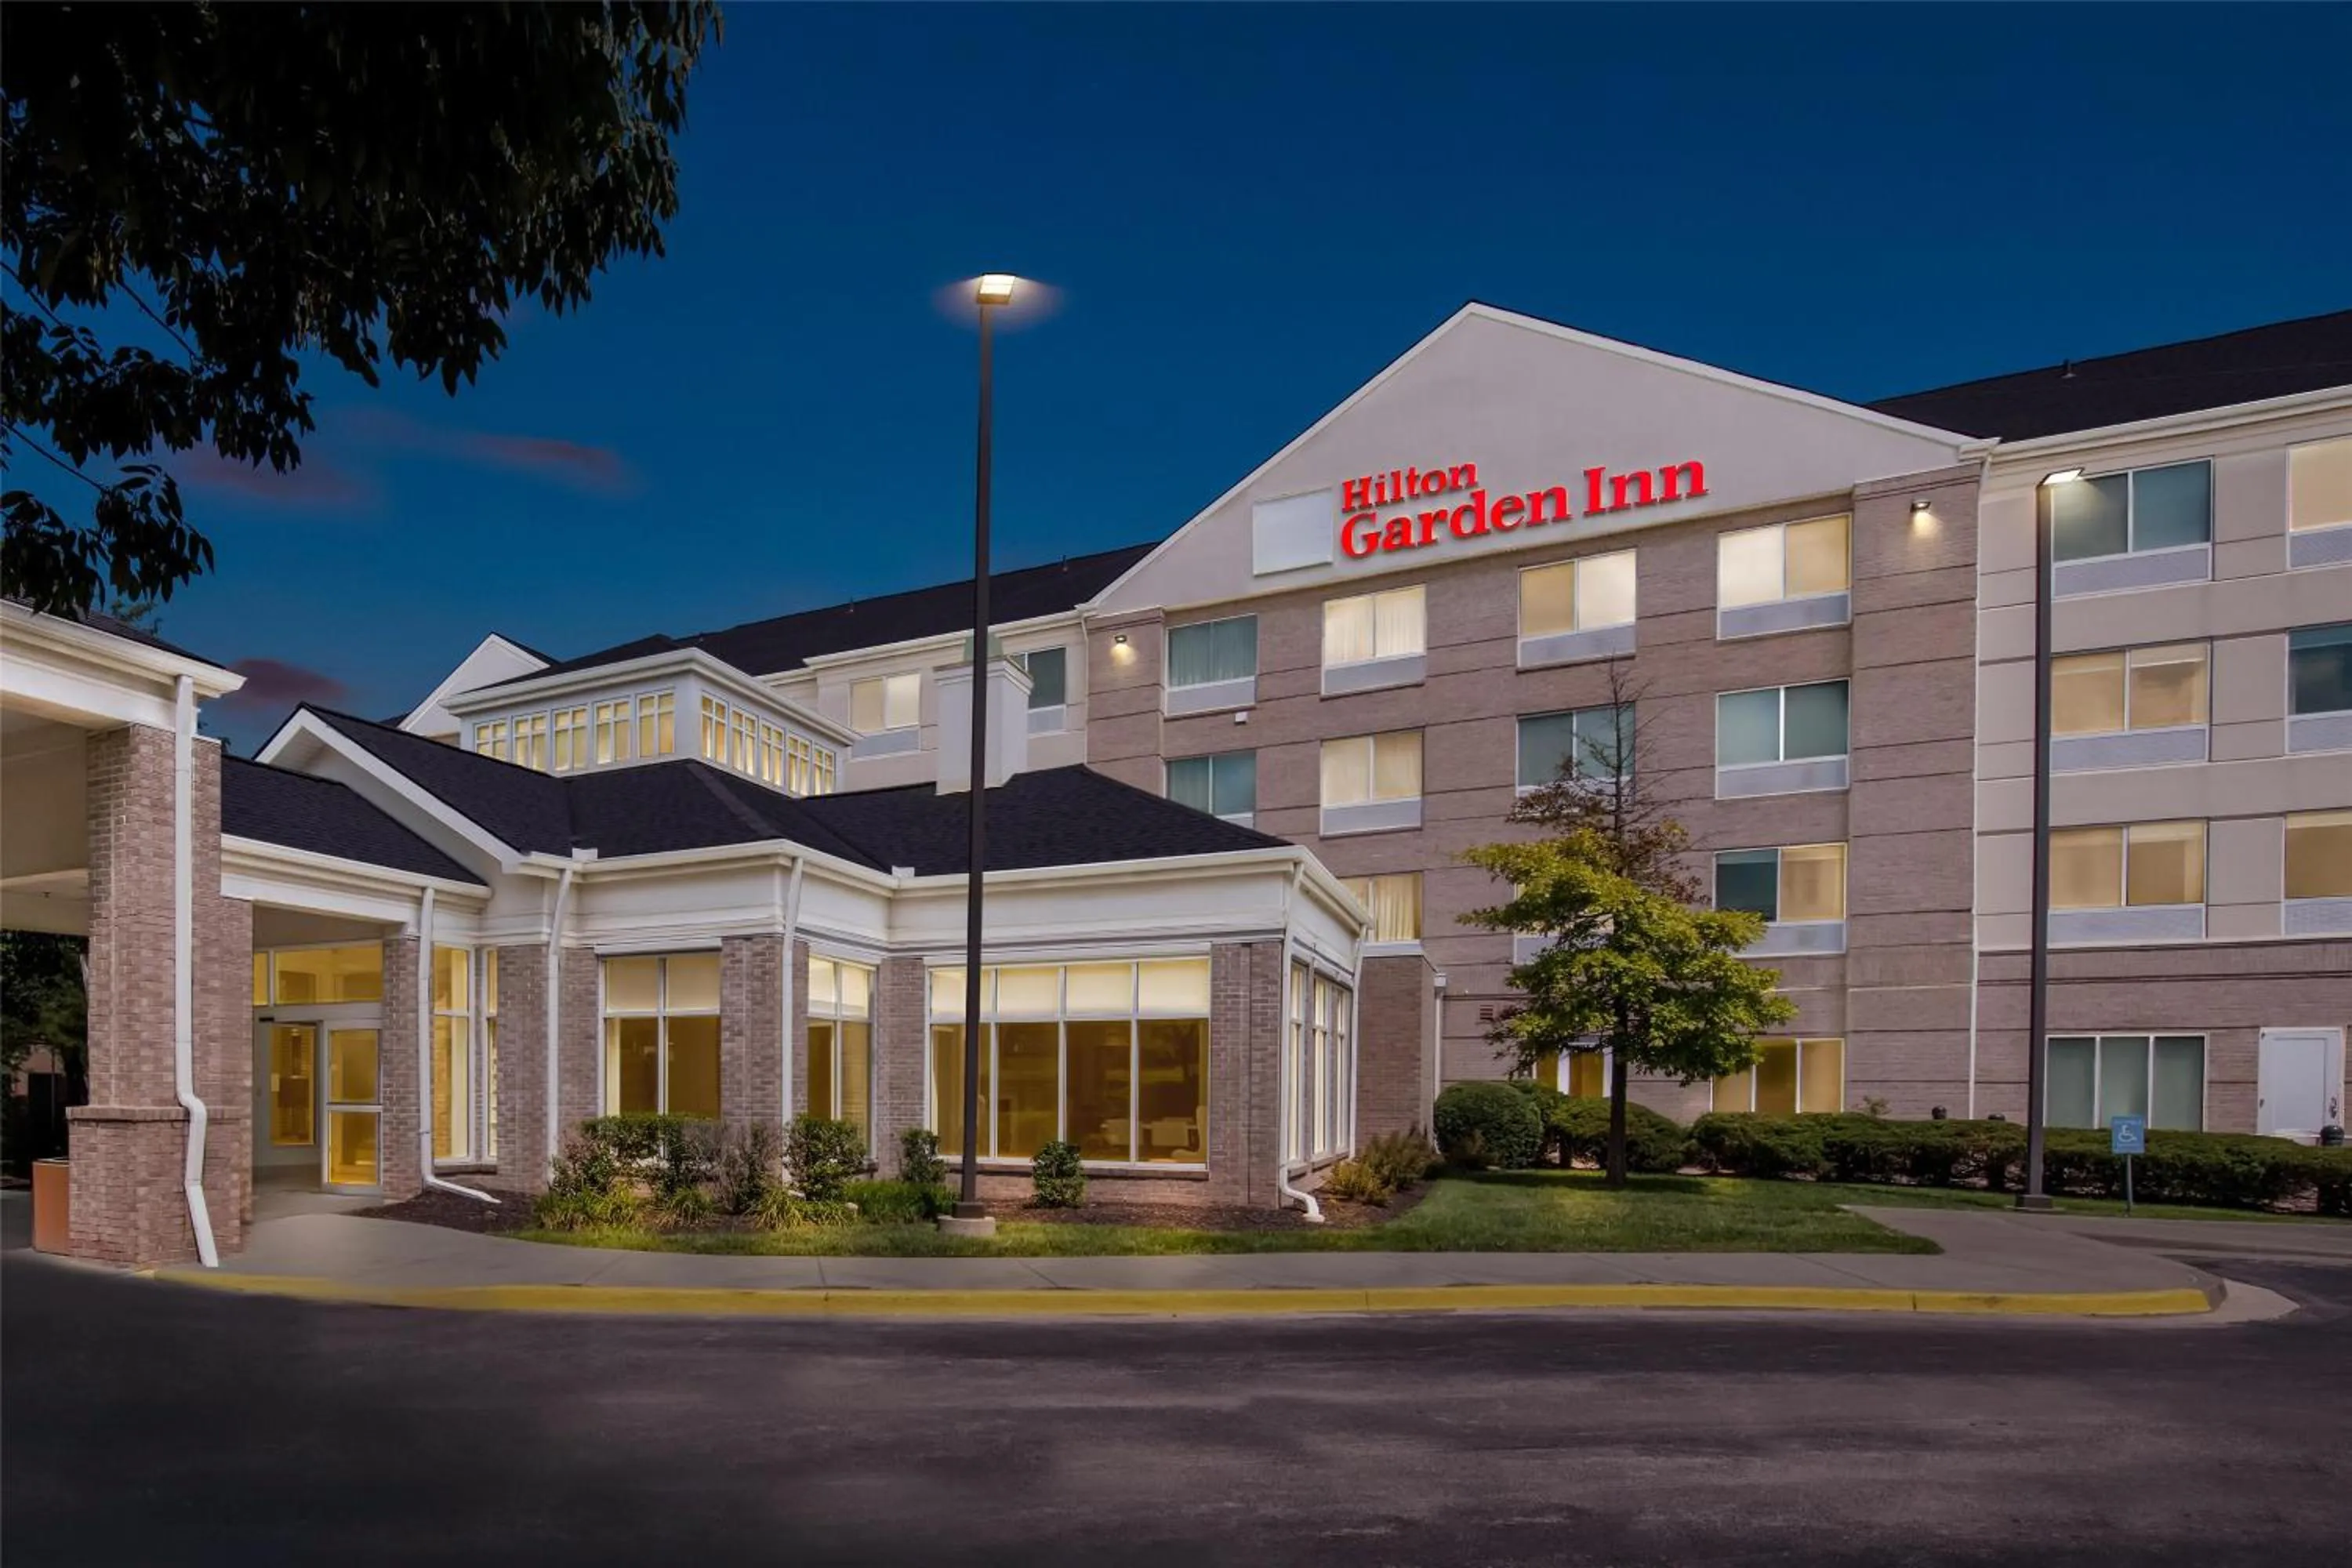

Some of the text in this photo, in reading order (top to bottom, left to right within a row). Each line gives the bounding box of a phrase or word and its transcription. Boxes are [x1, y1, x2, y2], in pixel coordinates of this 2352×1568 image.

[1340, 459, 1709, 558] Garden Inn
[1341, 463, 1478, 514] Hilton
